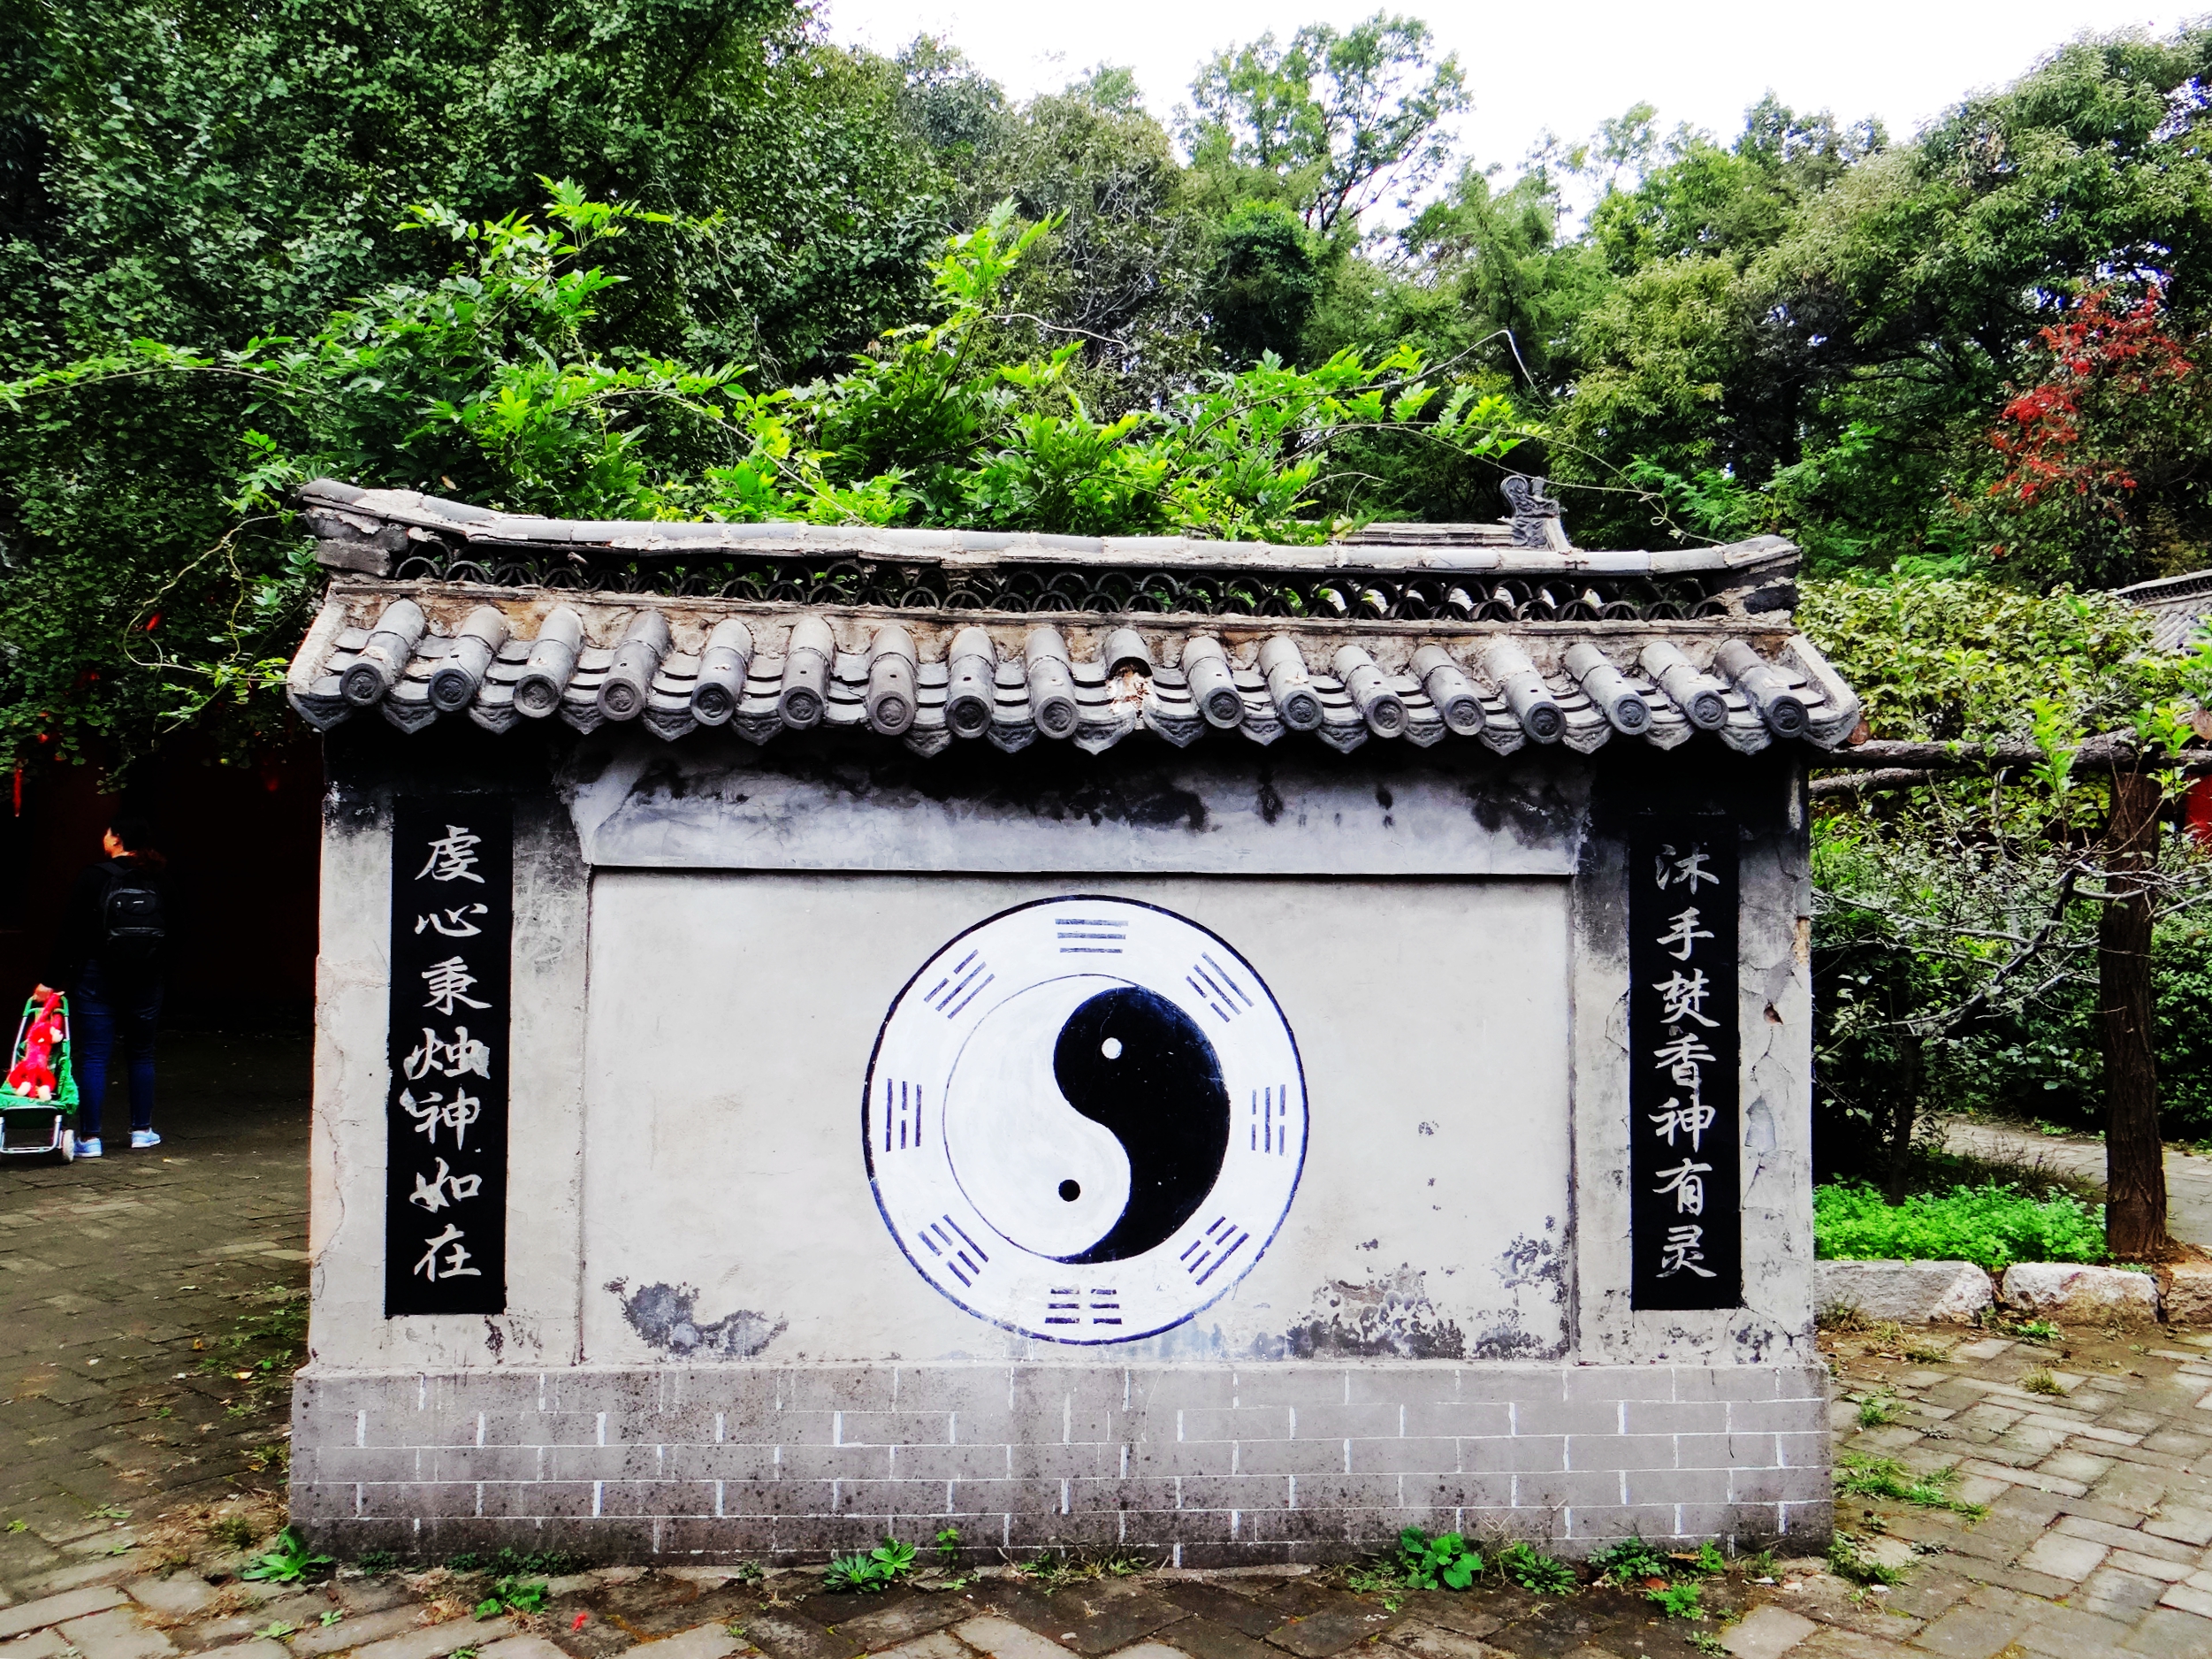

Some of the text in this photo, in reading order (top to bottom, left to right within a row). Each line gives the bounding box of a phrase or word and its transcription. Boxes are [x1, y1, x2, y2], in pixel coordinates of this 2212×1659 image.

[399, 824, 491, 1283] 虔心秉烛神如在
[1648, 842, 1720, 1279] 沐手焚香神有灵
